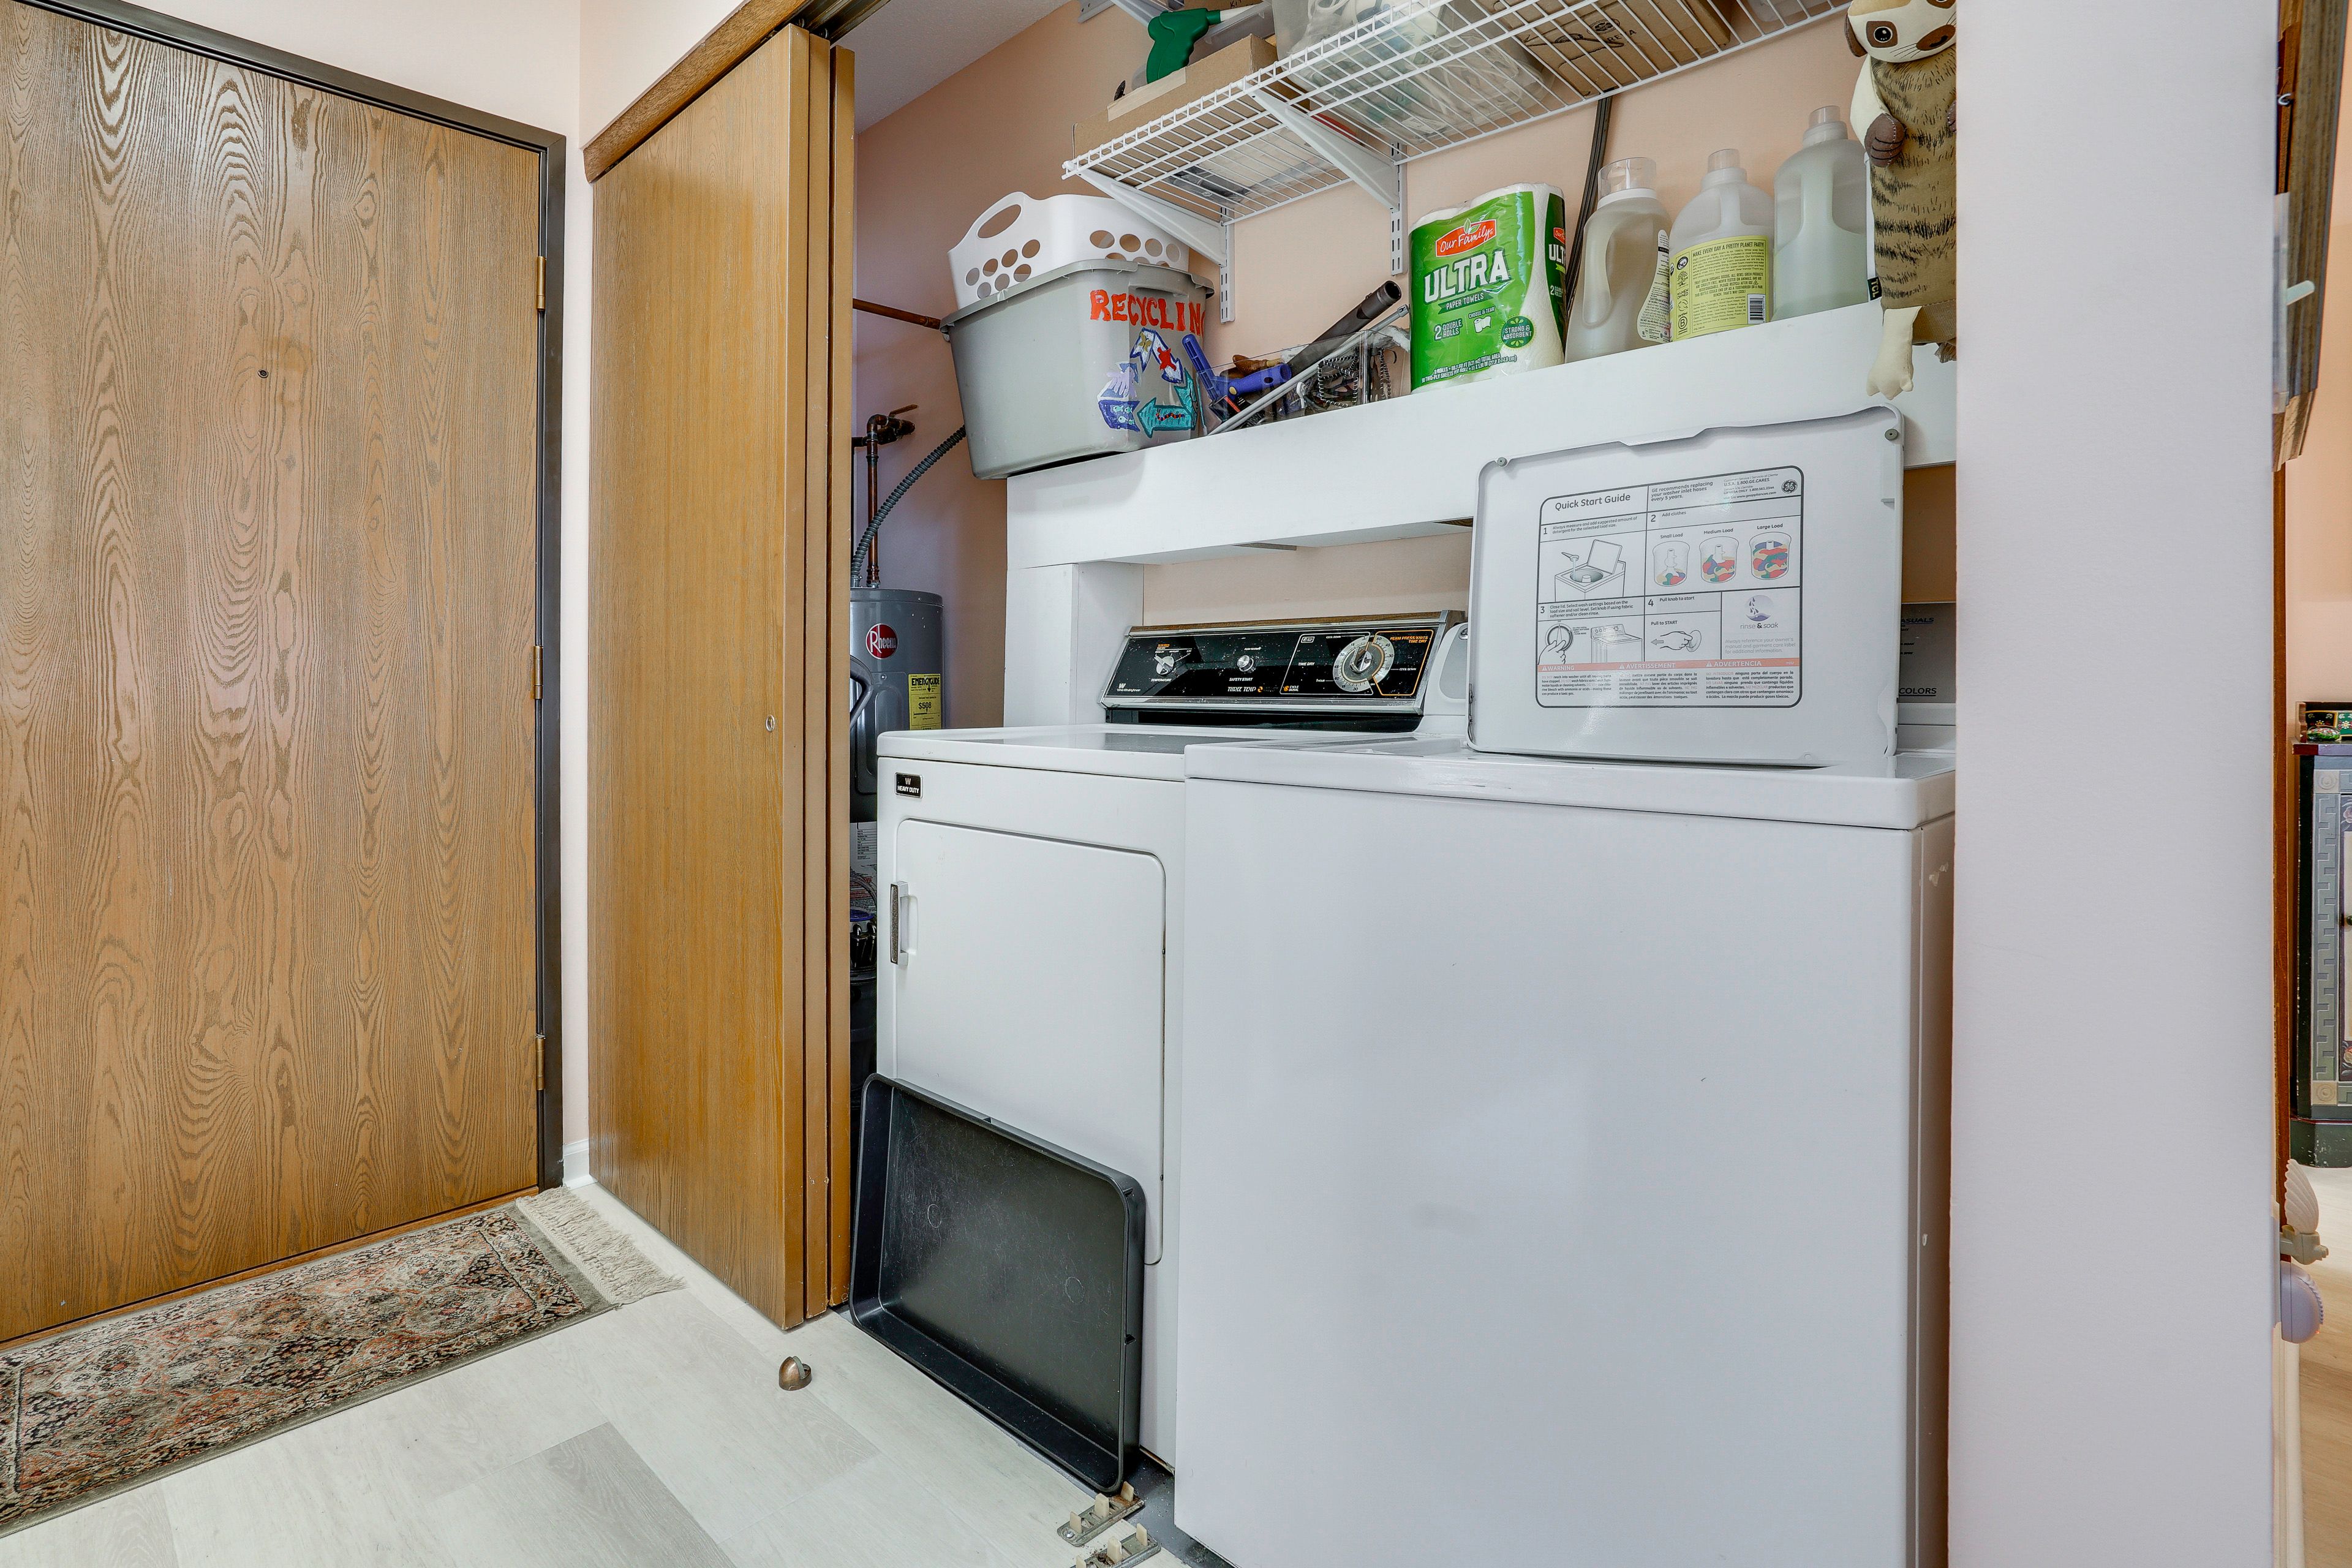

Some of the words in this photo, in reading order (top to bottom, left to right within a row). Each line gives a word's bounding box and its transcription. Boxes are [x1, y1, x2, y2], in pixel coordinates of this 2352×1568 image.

[1440, 239, 1457, 252] Our
[1458, 225, 1493, 247] Family
[1548, 244, 1565, 264] ULT
[1425, 251, 1509, 303] ULTRA
[1550, 285, 1555, 295] 2
[1446, 300, 1461, 310] PAPER
[1463, 293, 1484, 304] TOWELS
[1469, 310, 1482, 318] CHOOSE
[1435, 325, 1441, 340] 2
[1442, 319, 1462, 331] DOUBLE
[1443, 328, 1460, 337] ROLLS
[1504, 325, 1525, 334] STRONG
[1503, 331, 1531, 340] ABSORBENT
[1555, 499, 1579, 511] Quick
[1581, 497, 1602, 507] Start
[1605, 493, 1630, 503] Guide
[870, 625, 896, 654] Rheem
